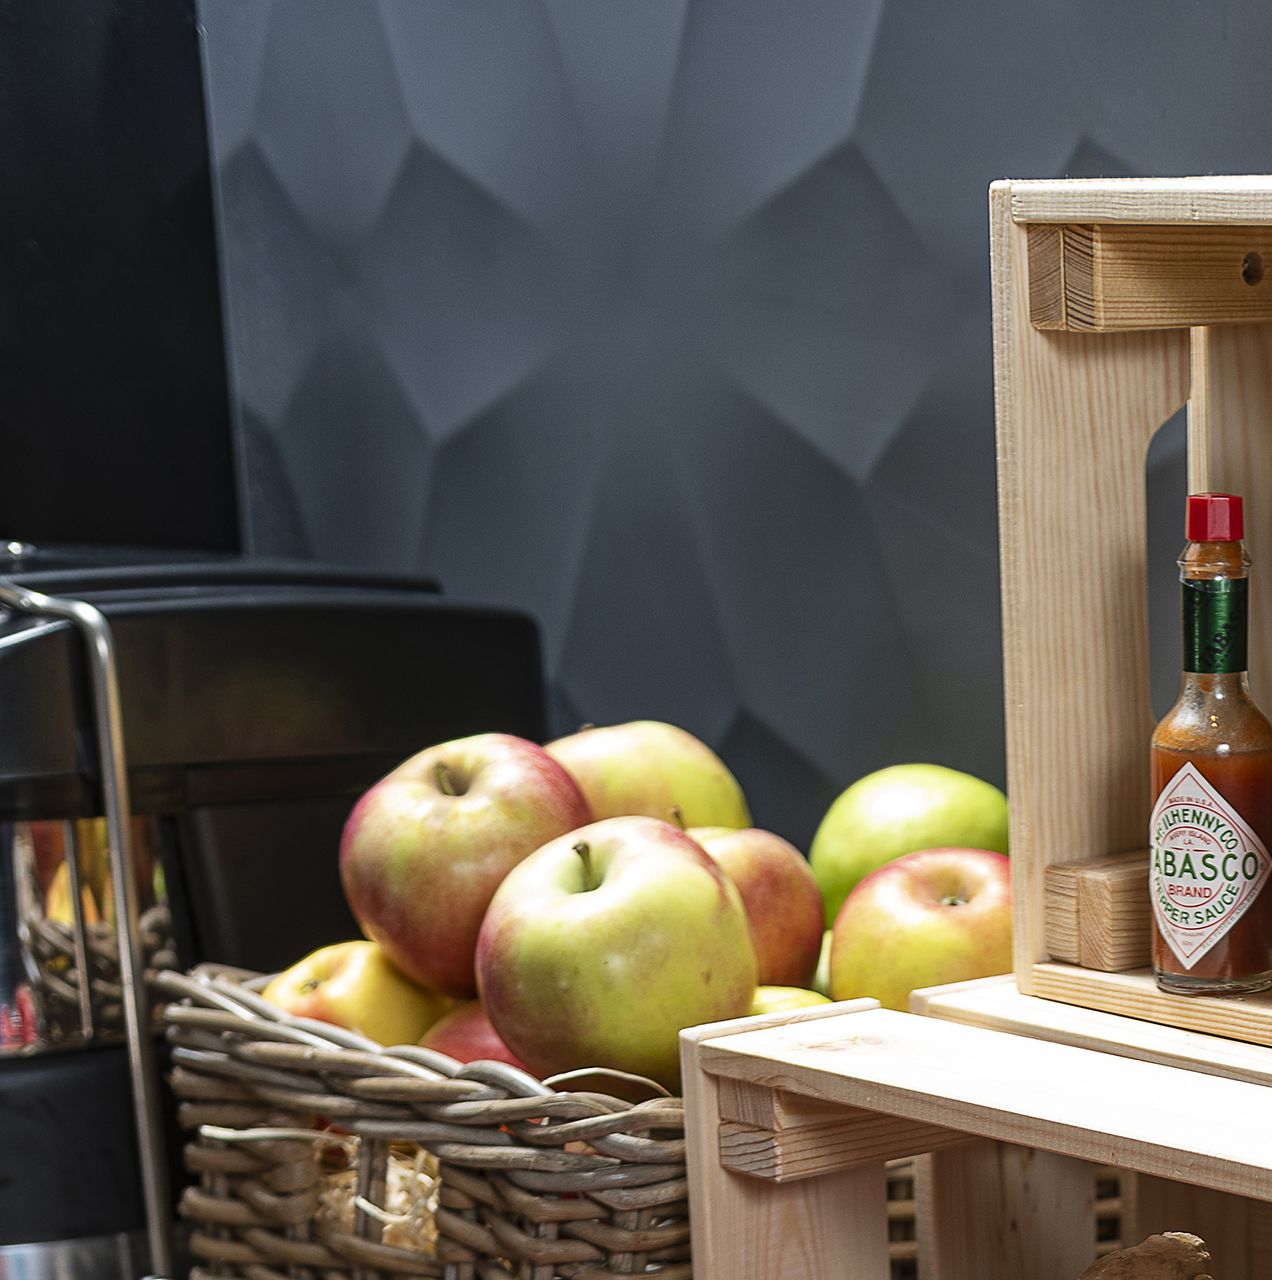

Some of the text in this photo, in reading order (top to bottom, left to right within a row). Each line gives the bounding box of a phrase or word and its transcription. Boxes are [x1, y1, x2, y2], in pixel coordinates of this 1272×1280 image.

[1153, 847, 1259, 882] ABASCO
[1168, 884, 1212, 898] BRAND
[1194, 883, 1240, 925] SAUCE
